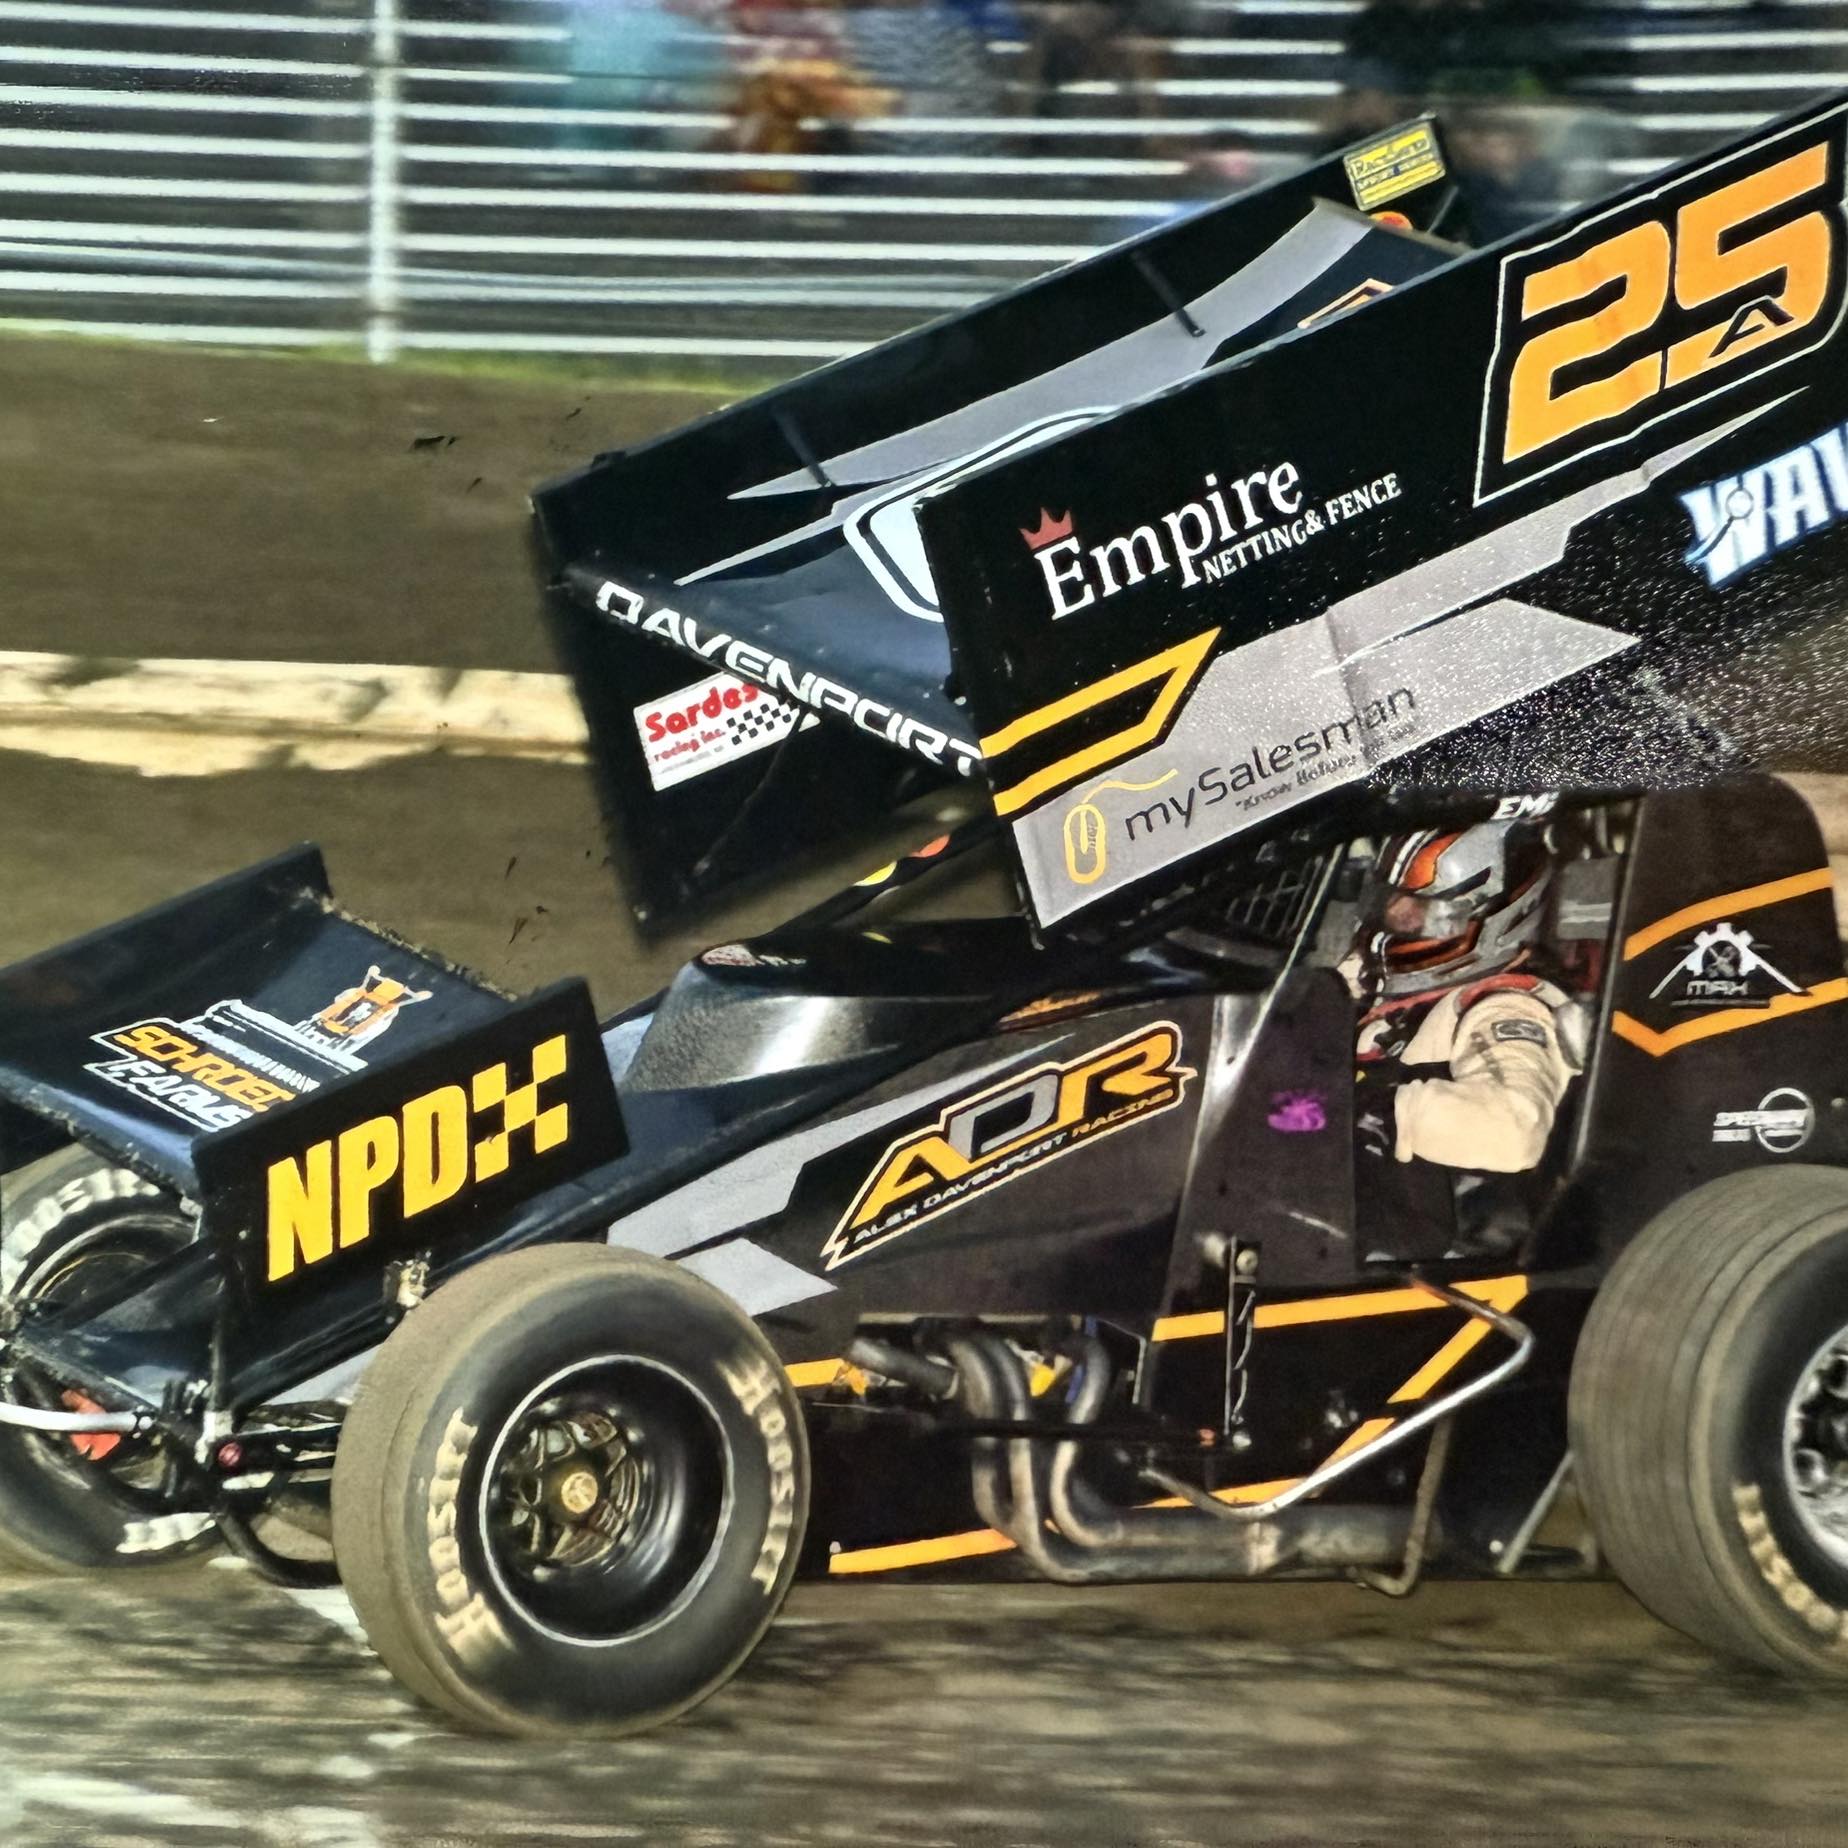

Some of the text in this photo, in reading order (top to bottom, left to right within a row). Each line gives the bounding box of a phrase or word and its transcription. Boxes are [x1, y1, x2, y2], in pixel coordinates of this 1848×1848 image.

[1503, 141, 1831, 464] 25
[1034, 462, 1303, 621] Empire
[1325, 472, 1403, 526] FENCE
[596, 580, 983, 777] DAVENPORT
[1125, 687, 1416, 841] mySalesman
[267, 1085, 468, 1282] NPD
[849, 1033, 1176, 1230] ADR
[852, 1200, 918, 1244] ALEX
